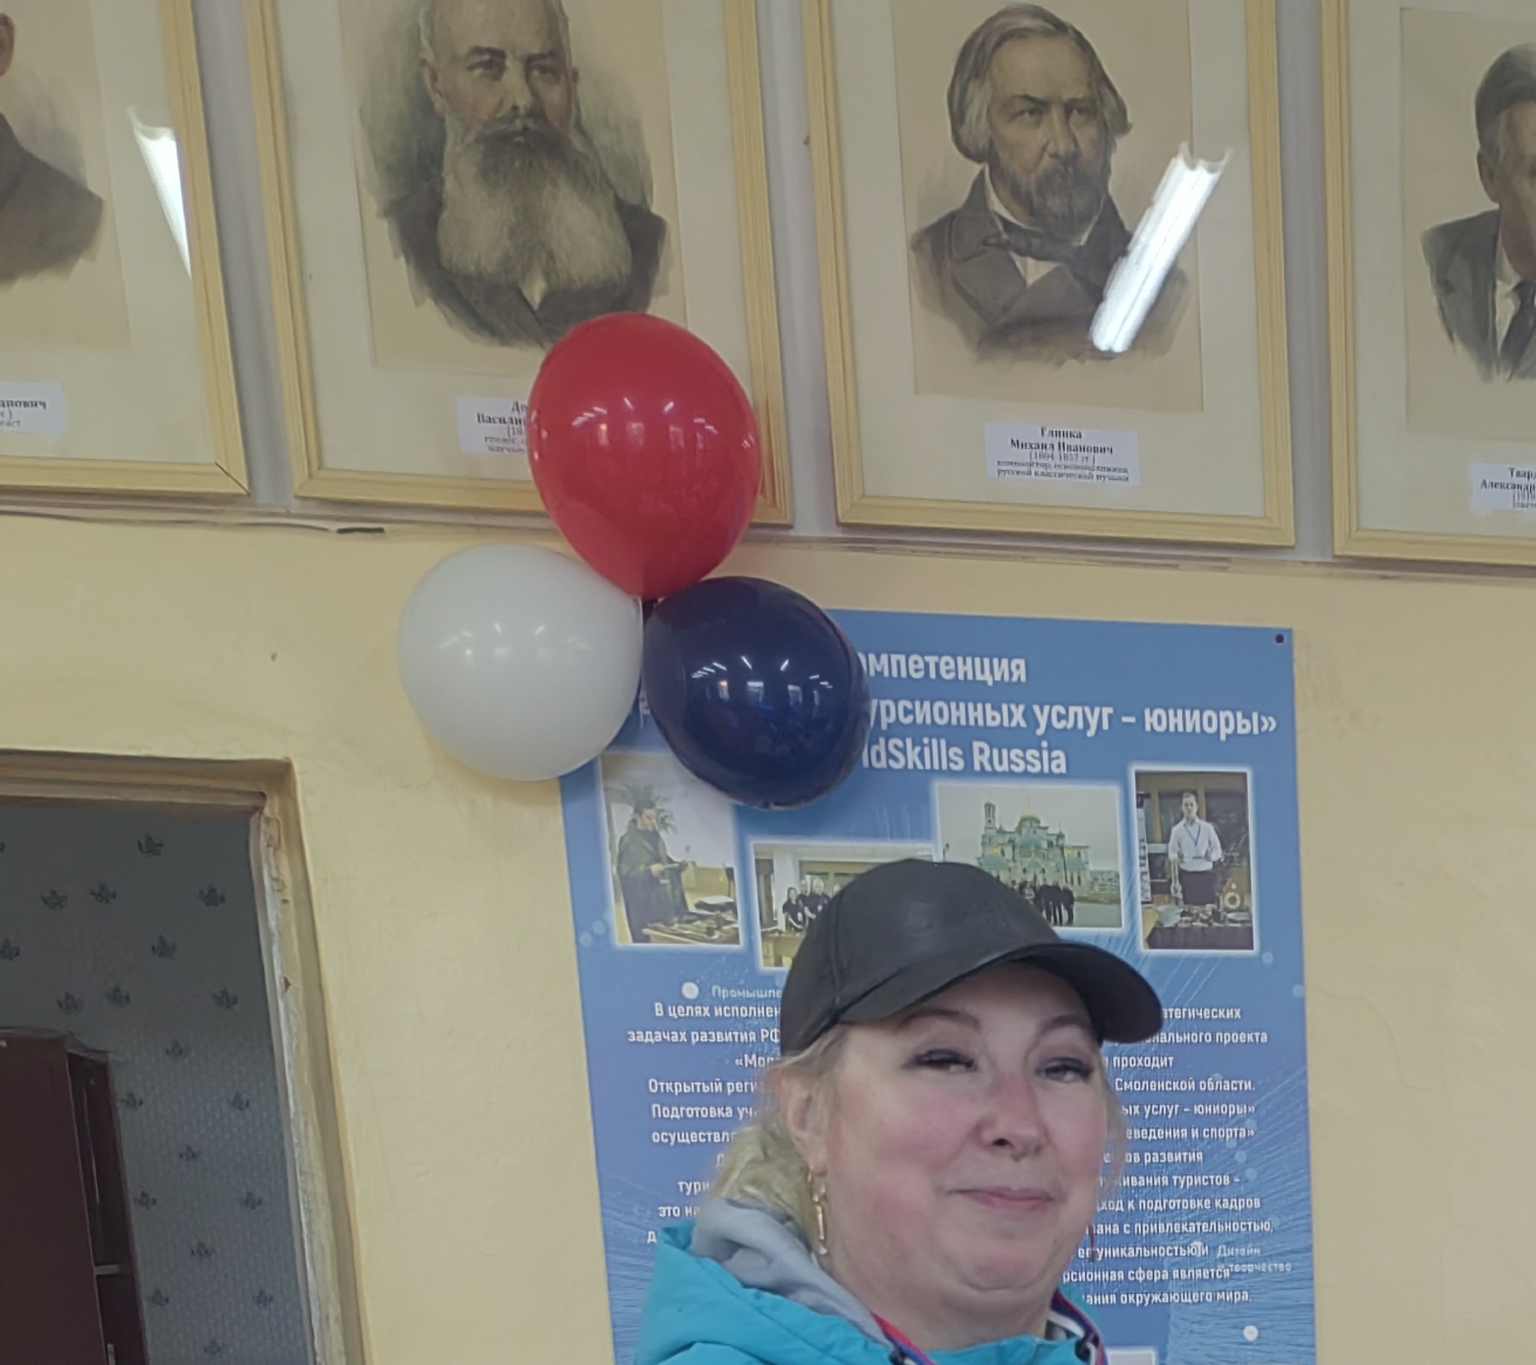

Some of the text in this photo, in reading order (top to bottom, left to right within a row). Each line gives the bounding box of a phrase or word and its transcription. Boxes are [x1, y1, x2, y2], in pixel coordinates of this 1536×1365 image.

[1041, 427, 1082, 440] Глинка
[1011, 438, 1113, 455] Михаил Иванович
[1480, 479, 1536, 493] Александр
[1032, 702, 1114, 738] услуг
[1144, 707, 1277, 741] юниоры»
[973, 740, 1067, 775] Russia
[654, 1002, 665, 1017] В
[668, 1004, 711, 1019] целях
[714, 1005, 781, 1018] исполнен
[627, 1030, 688, 1044] задачах
[691, 1030, 757, 1045] развития
[1215, 1031, 1268, 1046] проекта
[1113, 1055, 1175, 1070] проходит
[648, 1079, 723, 1096] Открытый
[1114, 1078, 1195, 1092] Смоленской
[1199, 1079, 1256, 1092] области.
[651, 1104, 733, 1119] Подготовка
[1143, 1104, 1180, 1119] услуг
[1191, 1128, 1199, 1139] и
[1202, 1127, 1256, 1141] спорта»
[1143, 1150, 1204, 1165] развития
[1172, 1174, 1230, 1189] туристов
[658, 1205, 681, 1217] это
[1127, 1199, 1136, 1211] к
[1139, 1198, 1212, 1212] подготовке
[1215, 1197, 1261, 1212] кадров
[1123, 1222, 1131, 1235] с
[1128, 1266, 1169, 1284] сфера
[1172, 1267, 1230, 1280] является
[1120, 1291, 1212, 1307] окружающего
